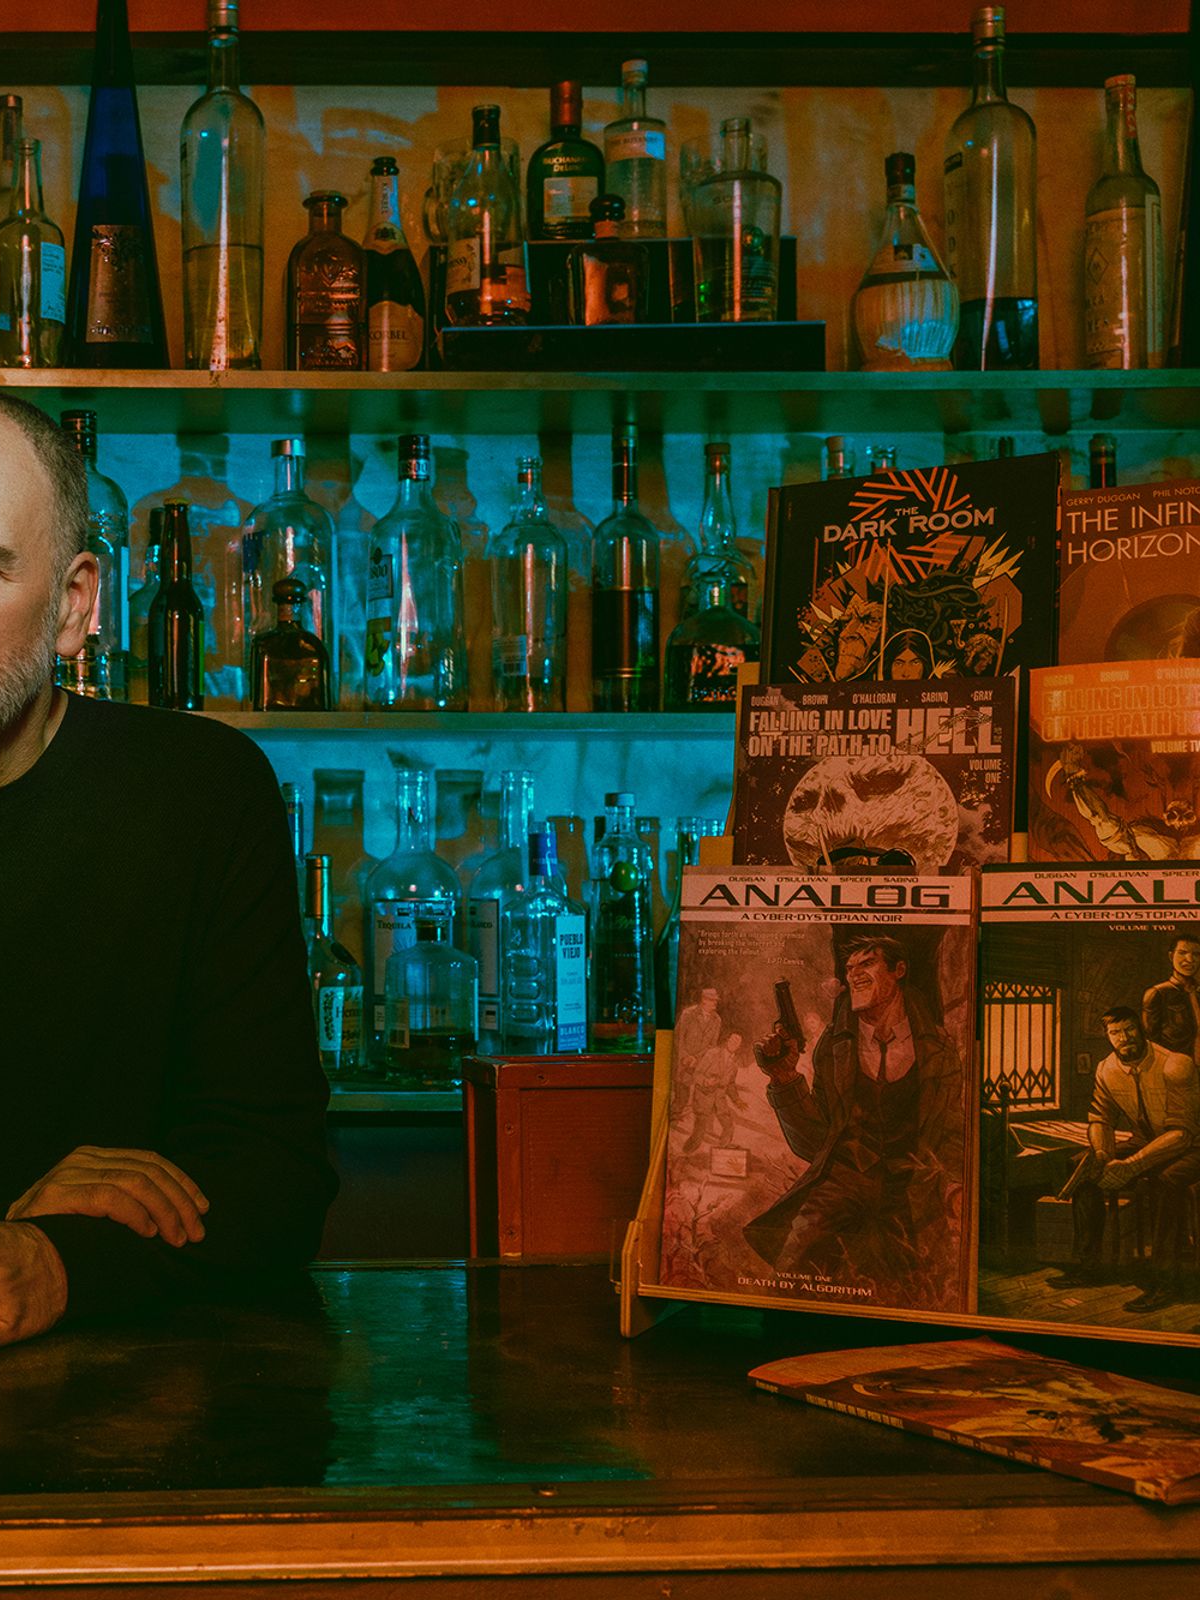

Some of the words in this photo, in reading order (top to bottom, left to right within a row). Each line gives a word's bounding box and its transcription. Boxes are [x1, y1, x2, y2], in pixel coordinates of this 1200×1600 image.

[369, 330, 407, 340] KOBEL
[1066, 498, 1094, 507] GERRY
[1097, 493, 1141, 504] DUGGAN
[1152, 489, 1170, 498] PHIL
[894, 506, 919, 518] THE
[823, 518, 898, 543] DARK
[908, 507, 995, 537] ROOM
[1066, 508, 1119, 535] THE
[750, 696, 779, 707] DUGGAN
[802, 695, 829, 706] BROWN
[852, 693, 897, 705] O'HALLORAN
[921, 691, 949, 703] SABINO
[973, 690, 993, 702] GRAY
[749, 710, 821, 733] FALLING
[824, 709, 844, 731] IN
[848, 709, 892, 731] LOVE
[896, 706, 1002, 755] HELL
[747, 735, 772, 757] ON
[774, 734, 812, 756] THE
[816, 733, 863, 756] PATH
[868, 733, 892, 756] TO
[969, 759, 1002, 771] VOLUME
[984, 772, 1002, 784] ONE
[698, 884, 950, 908] ANALOG
[1002, 880, 1200, 905] ANAL
[740, 913, 750, 922] A
[872, 914, 902, 925] NOIR
[1050, 912, 1061, 921] A
[560, 933, 584, 946] PUEBLO
[562, 947, 581, 960] VIEJO
[776, 1271, 812, 1282] VOLUME
[815, 1275, 832, 1283] ONE
[737, 1276, 776, 1289] DEATH
[779, 1280, 796, 1291] BY
[800, 1283, 872, 1298] ALGORITHM
